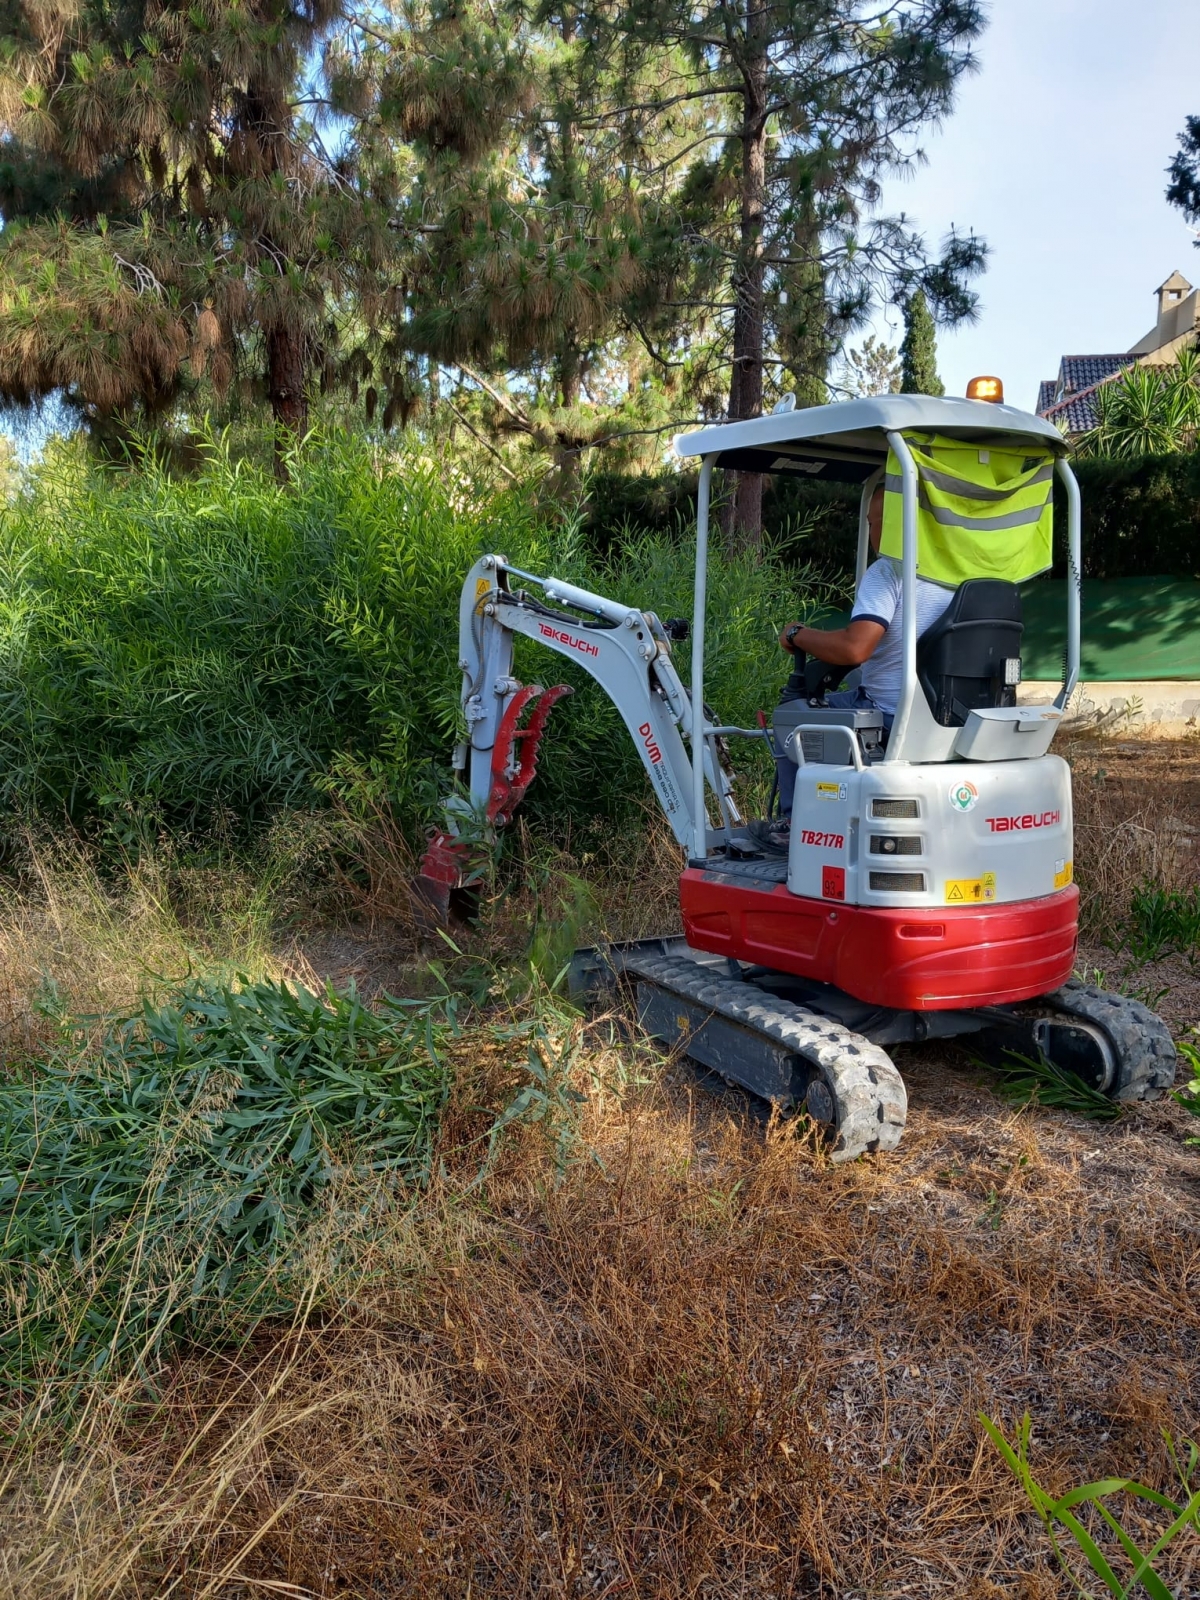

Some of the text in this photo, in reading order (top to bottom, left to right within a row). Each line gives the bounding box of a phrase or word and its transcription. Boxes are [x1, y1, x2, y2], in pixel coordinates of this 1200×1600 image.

[538, 622, 599, 657] TAKEUCHI
[639, 722, 662, 764] DVM
[984, 809, 1060, 832] TAKEUCHI
[801, 829, 844, 849] TB217R
[825, 880, 836, 897] 93
